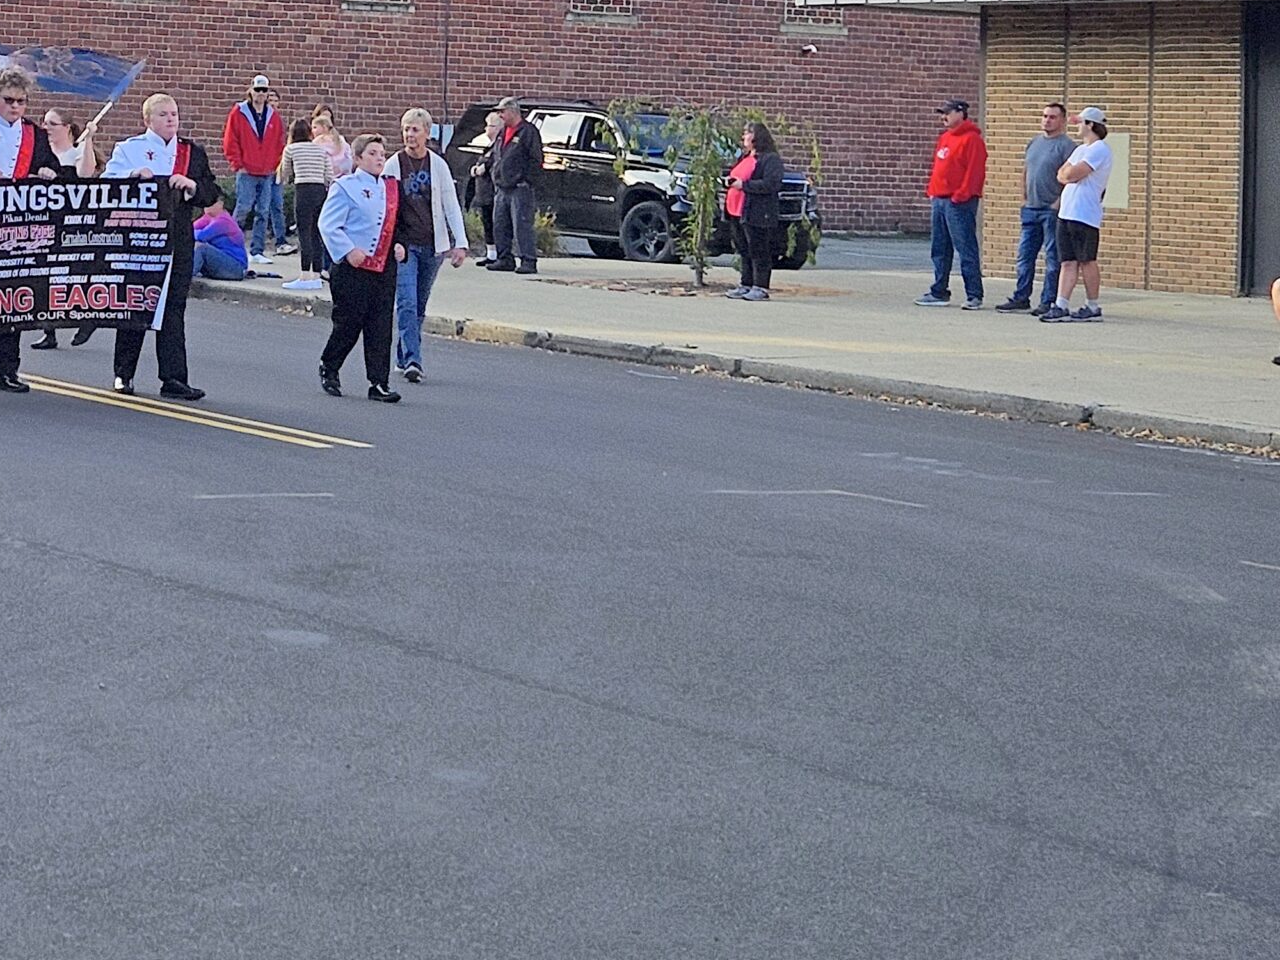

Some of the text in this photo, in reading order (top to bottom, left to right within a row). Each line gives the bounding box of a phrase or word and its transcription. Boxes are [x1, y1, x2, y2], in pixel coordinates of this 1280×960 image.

[48, 283, 161, 312] EAGLES
[0, 310, 35, 324] Thank
[36, 310, 66, 321] OUR
[69, 309, 132, 321] Sponsors!!
